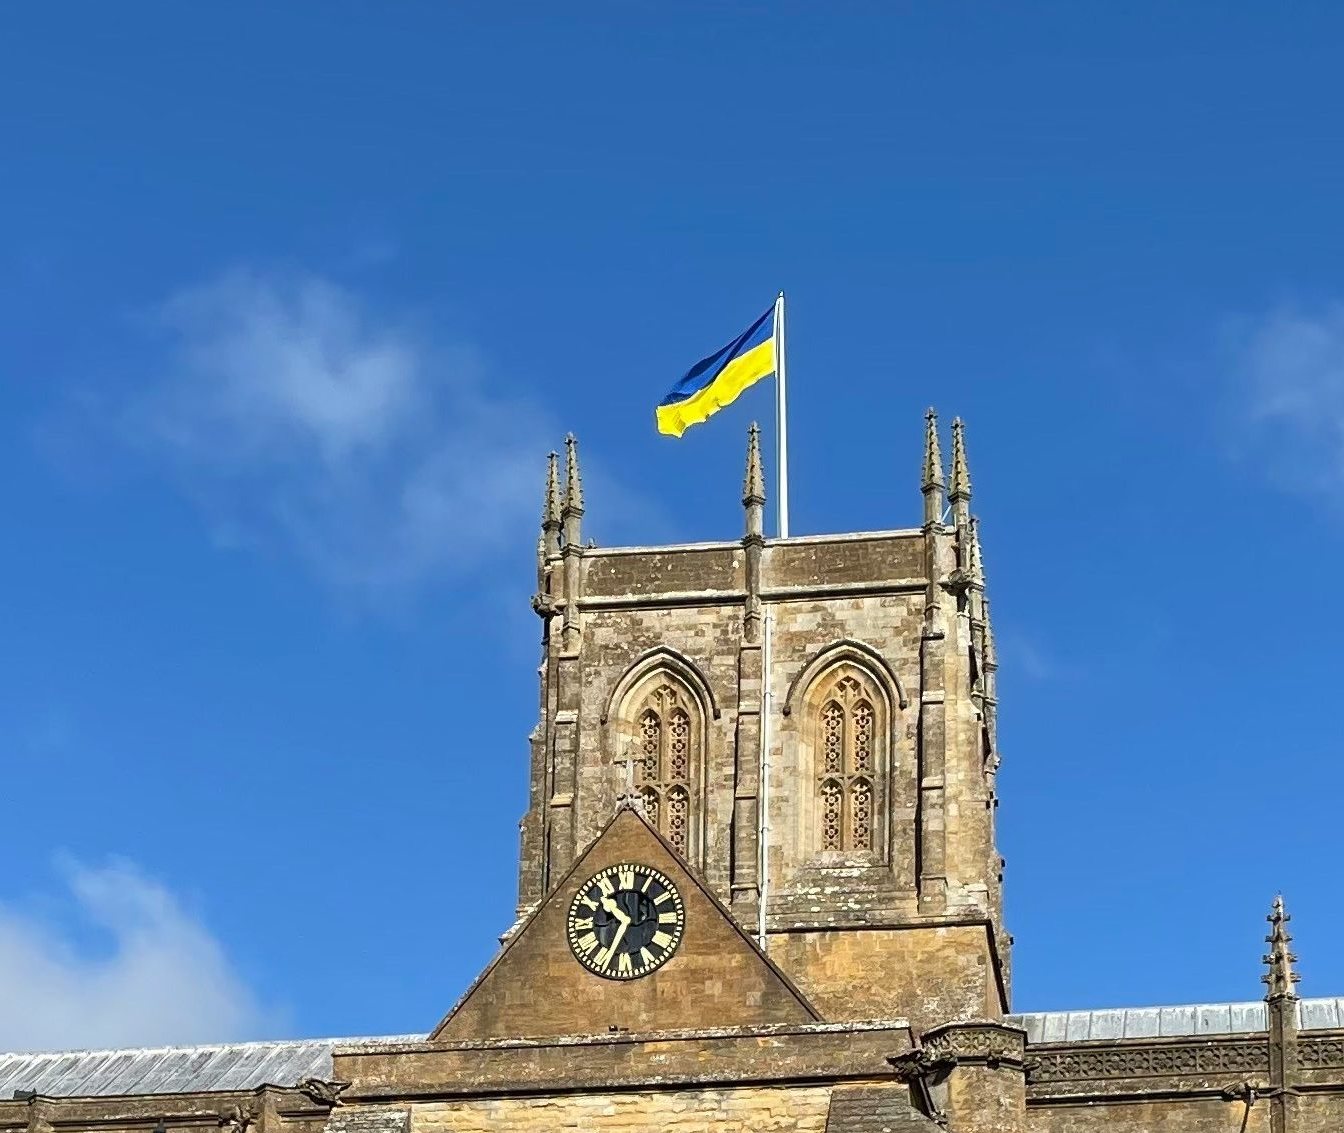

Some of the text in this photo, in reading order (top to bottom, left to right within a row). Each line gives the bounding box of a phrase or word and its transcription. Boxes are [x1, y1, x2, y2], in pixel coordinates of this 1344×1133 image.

[618, 871, 635, 891] XII
[641, 876, 653, 893] I
[580, 895, 600, 912] X
[653, 891, 672, 906] II
